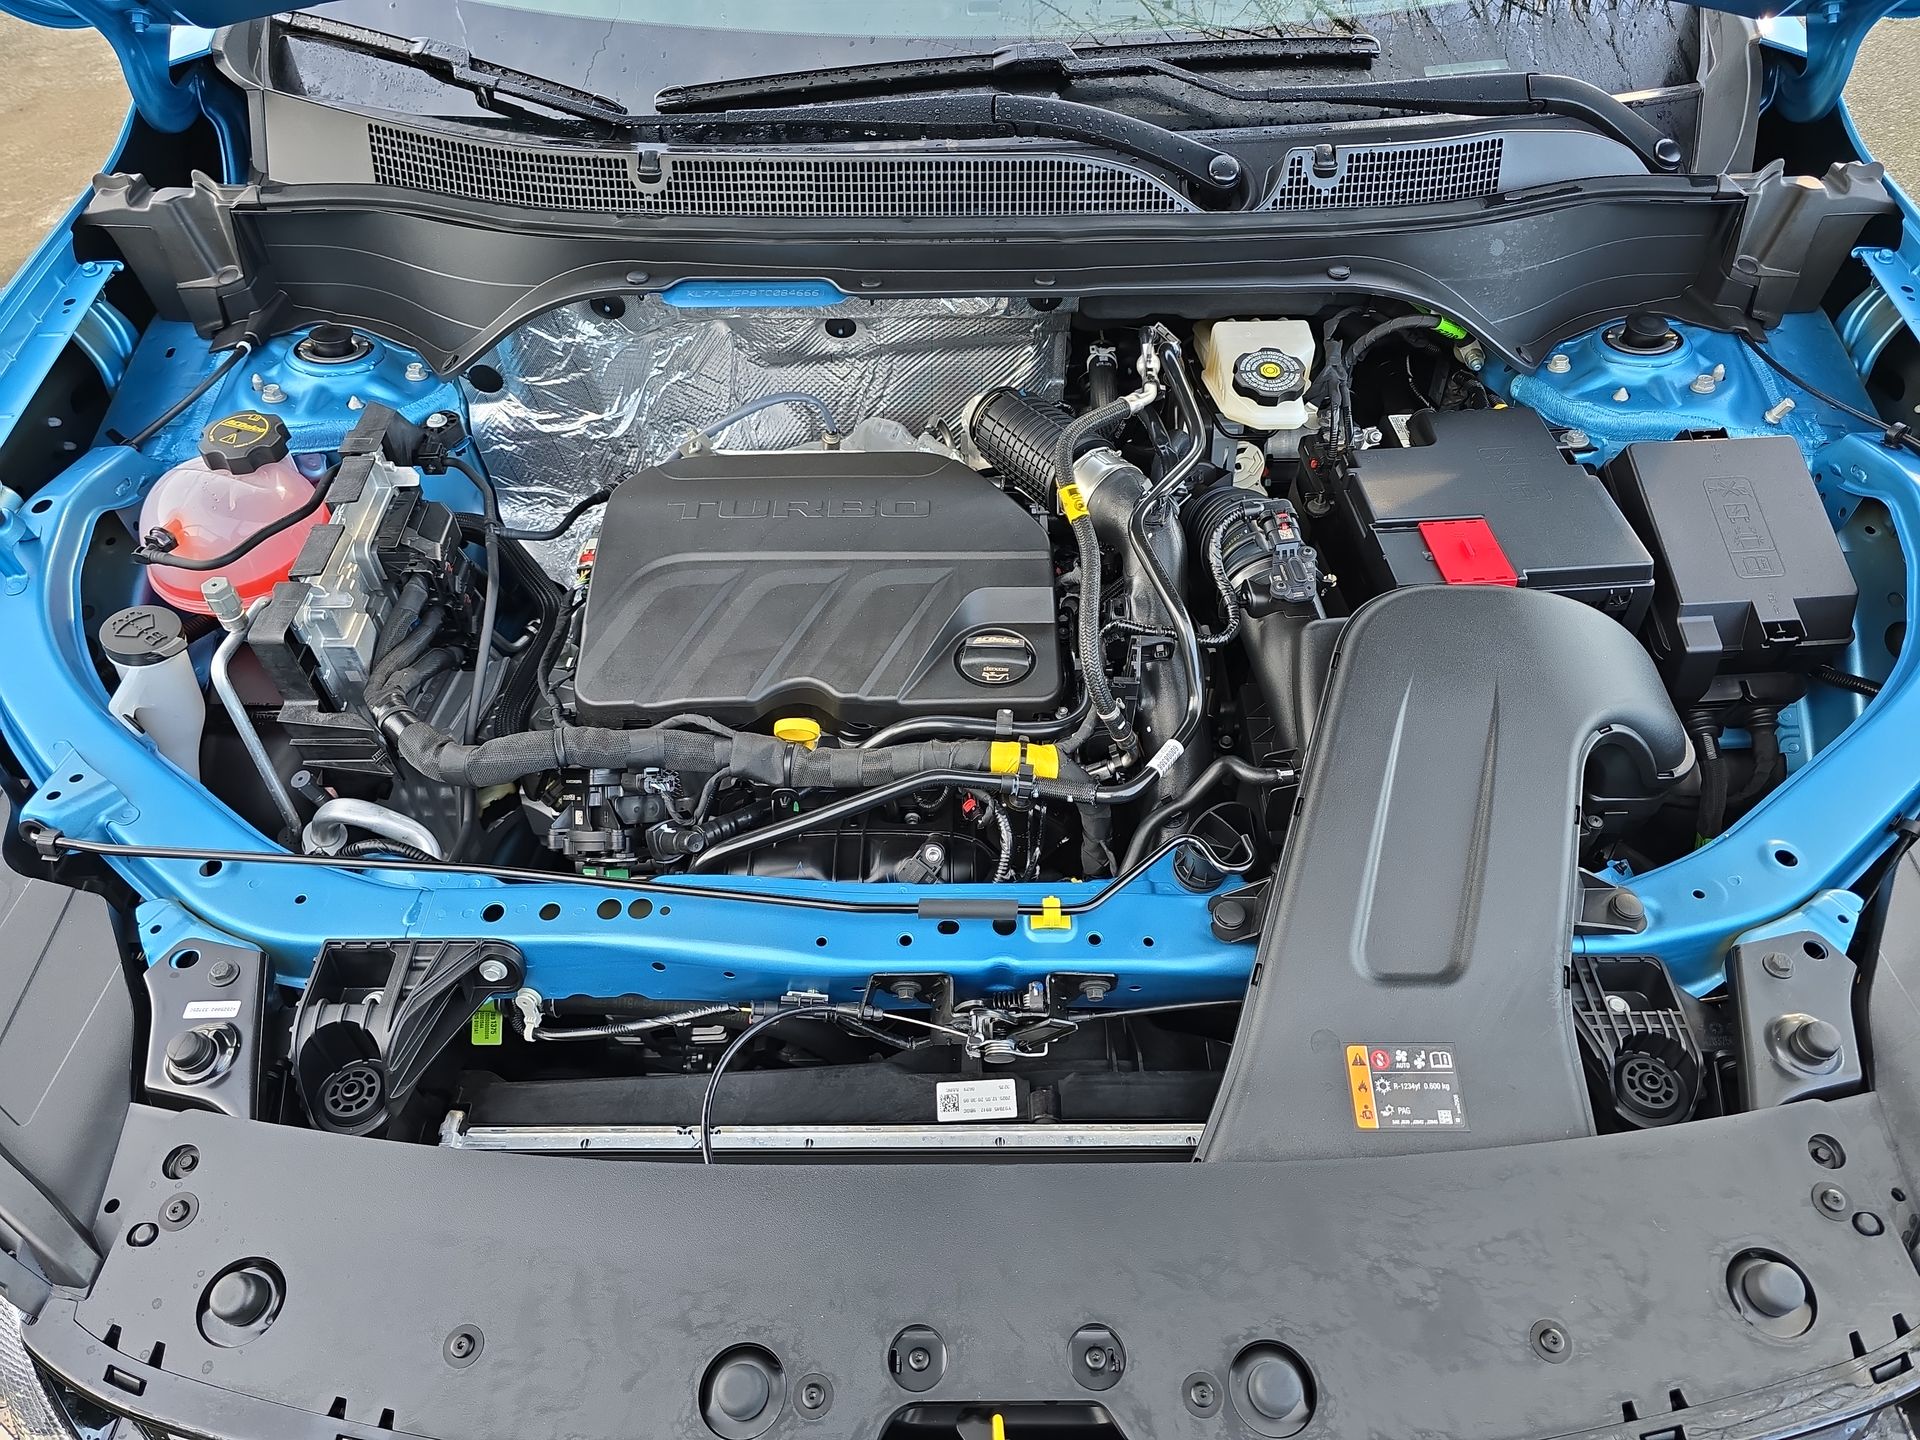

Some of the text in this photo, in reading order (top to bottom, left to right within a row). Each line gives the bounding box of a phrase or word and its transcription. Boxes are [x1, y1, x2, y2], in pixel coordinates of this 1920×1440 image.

[667, 499, 931, 520] TURBO
[973, 636, 1020, 644] ACDelco
[1393, 1082, 1421, 1092] R-1234yf
[1442, 1082, 1450, 1092] kg
[1398, 1107, 1411, 1115] PAG
